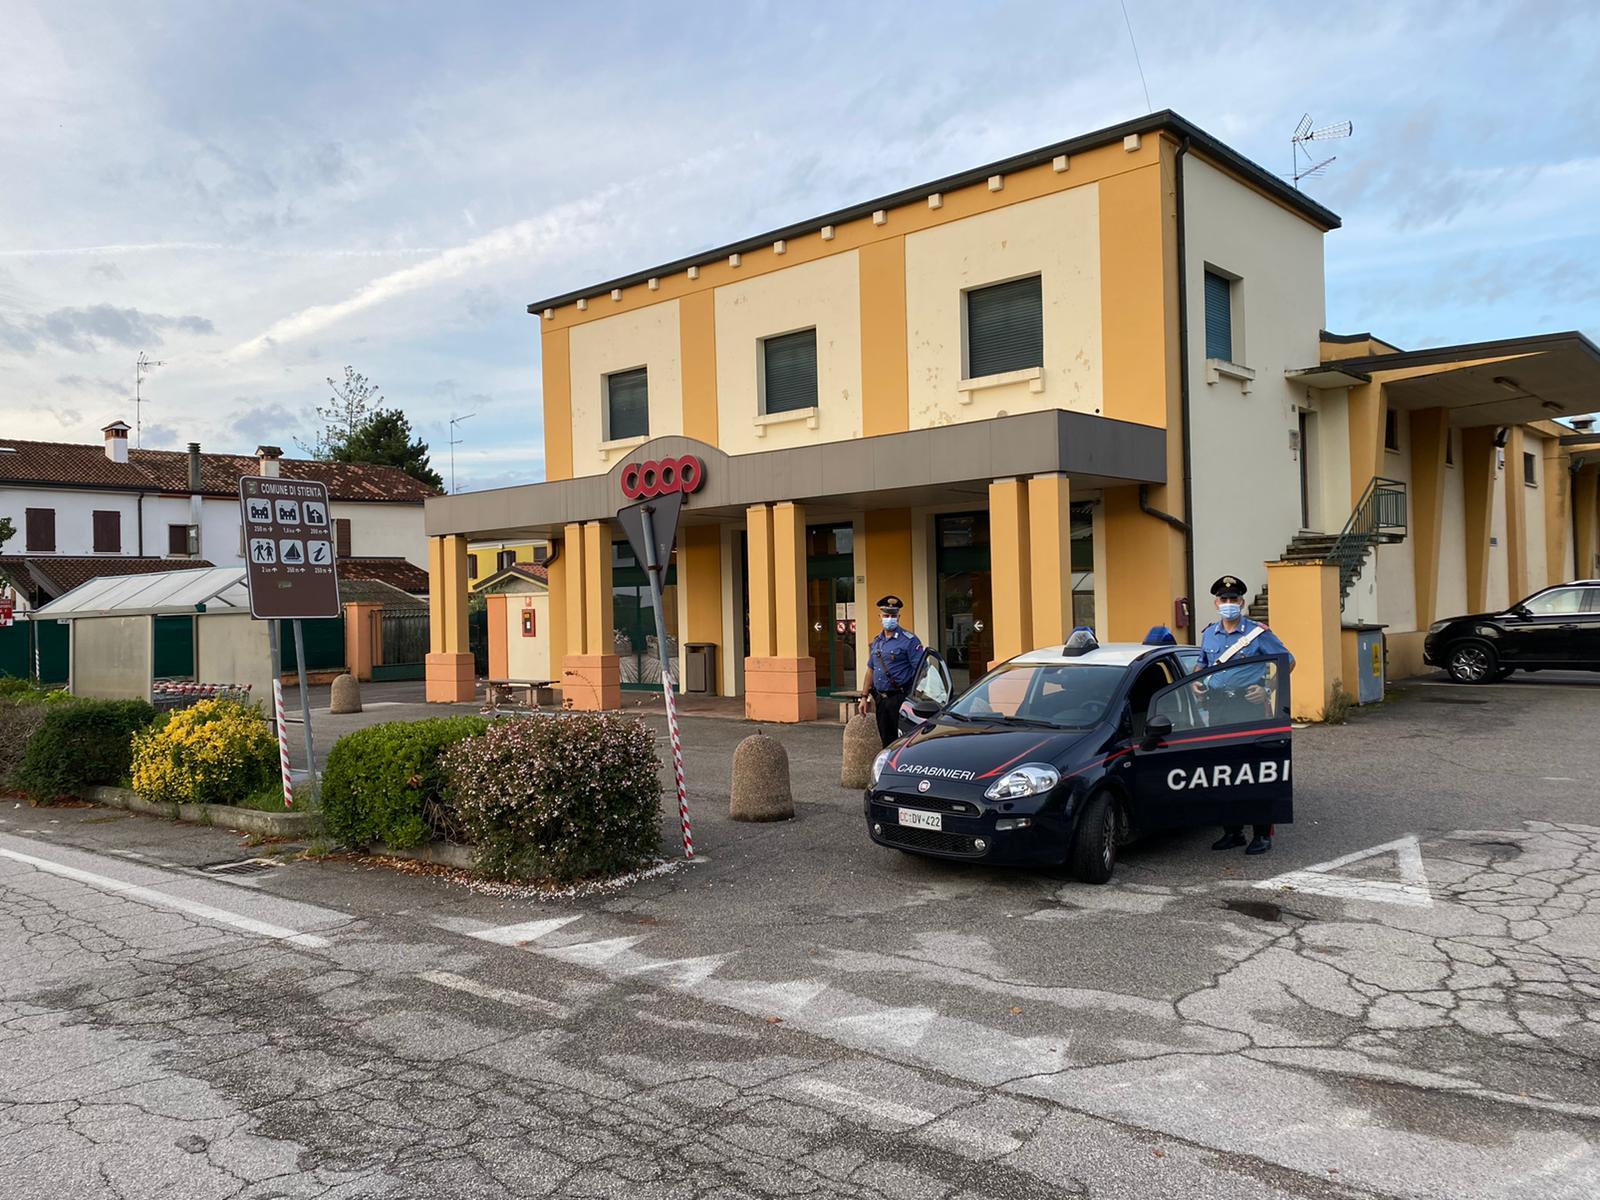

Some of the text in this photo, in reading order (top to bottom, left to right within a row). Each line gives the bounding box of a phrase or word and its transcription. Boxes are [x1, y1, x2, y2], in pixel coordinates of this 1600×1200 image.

[261, 483, 323, 497] COMUNE DI STIENTA
[897, 763, 976, 781] CARABINIERI
[1167, 759, 1290, 791] CARABI
